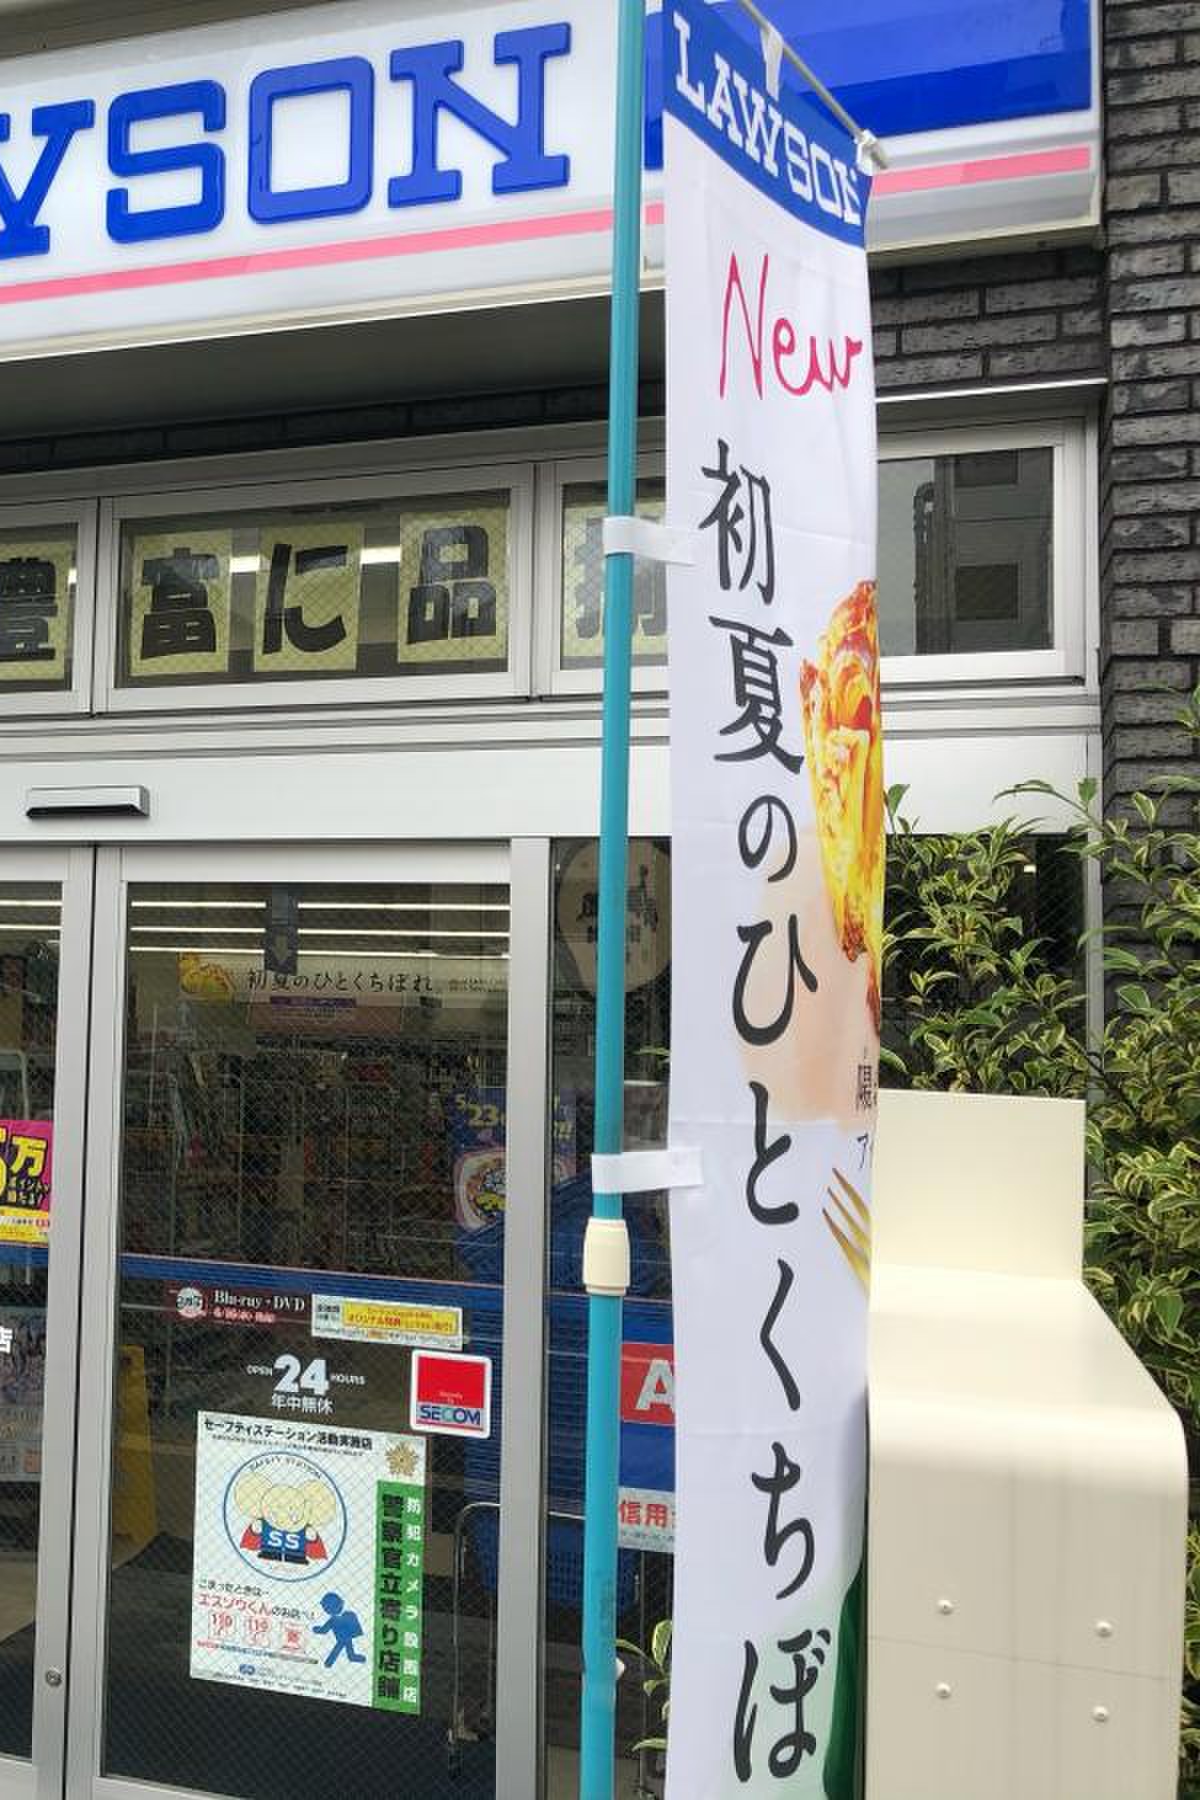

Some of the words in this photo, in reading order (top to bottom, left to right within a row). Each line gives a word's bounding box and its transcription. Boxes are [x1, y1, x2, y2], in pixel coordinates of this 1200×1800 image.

[719, 252, 863, 401] New
[247, 1364, 273, 1377] OPEN
[273, 1353, 330, 1396] 24
[330, 1373, 366, 1386] HOURS
[272, 1393, 335, 1416] 年中無休
[420, 1404, 481, 1426] SECOM
[267, 1530, 300, 1550] SS
